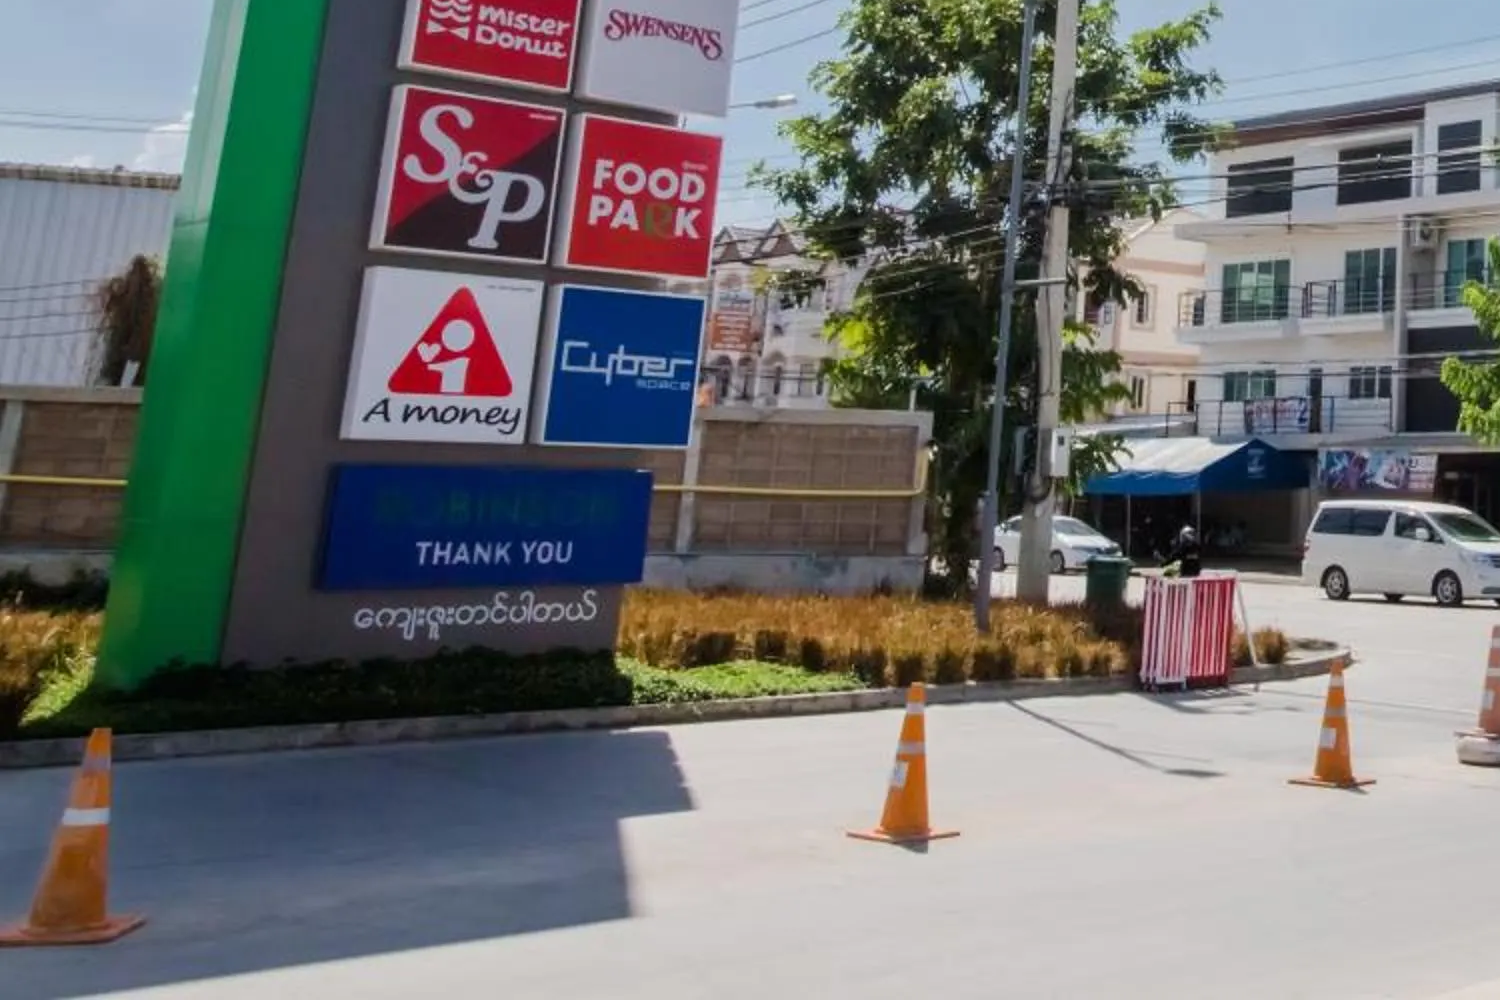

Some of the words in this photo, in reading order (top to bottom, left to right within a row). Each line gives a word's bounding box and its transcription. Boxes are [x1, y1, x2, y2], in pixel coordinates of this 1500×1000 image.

[593, 159, 705, 202] FOOD
[561, 339, 694, 387] Cyber
[361, 397, 391, 423] A
[401, 403, 522, 436] money
[415, 541, 512, 566] THANK
[521, 541, 574, 564] YOU
